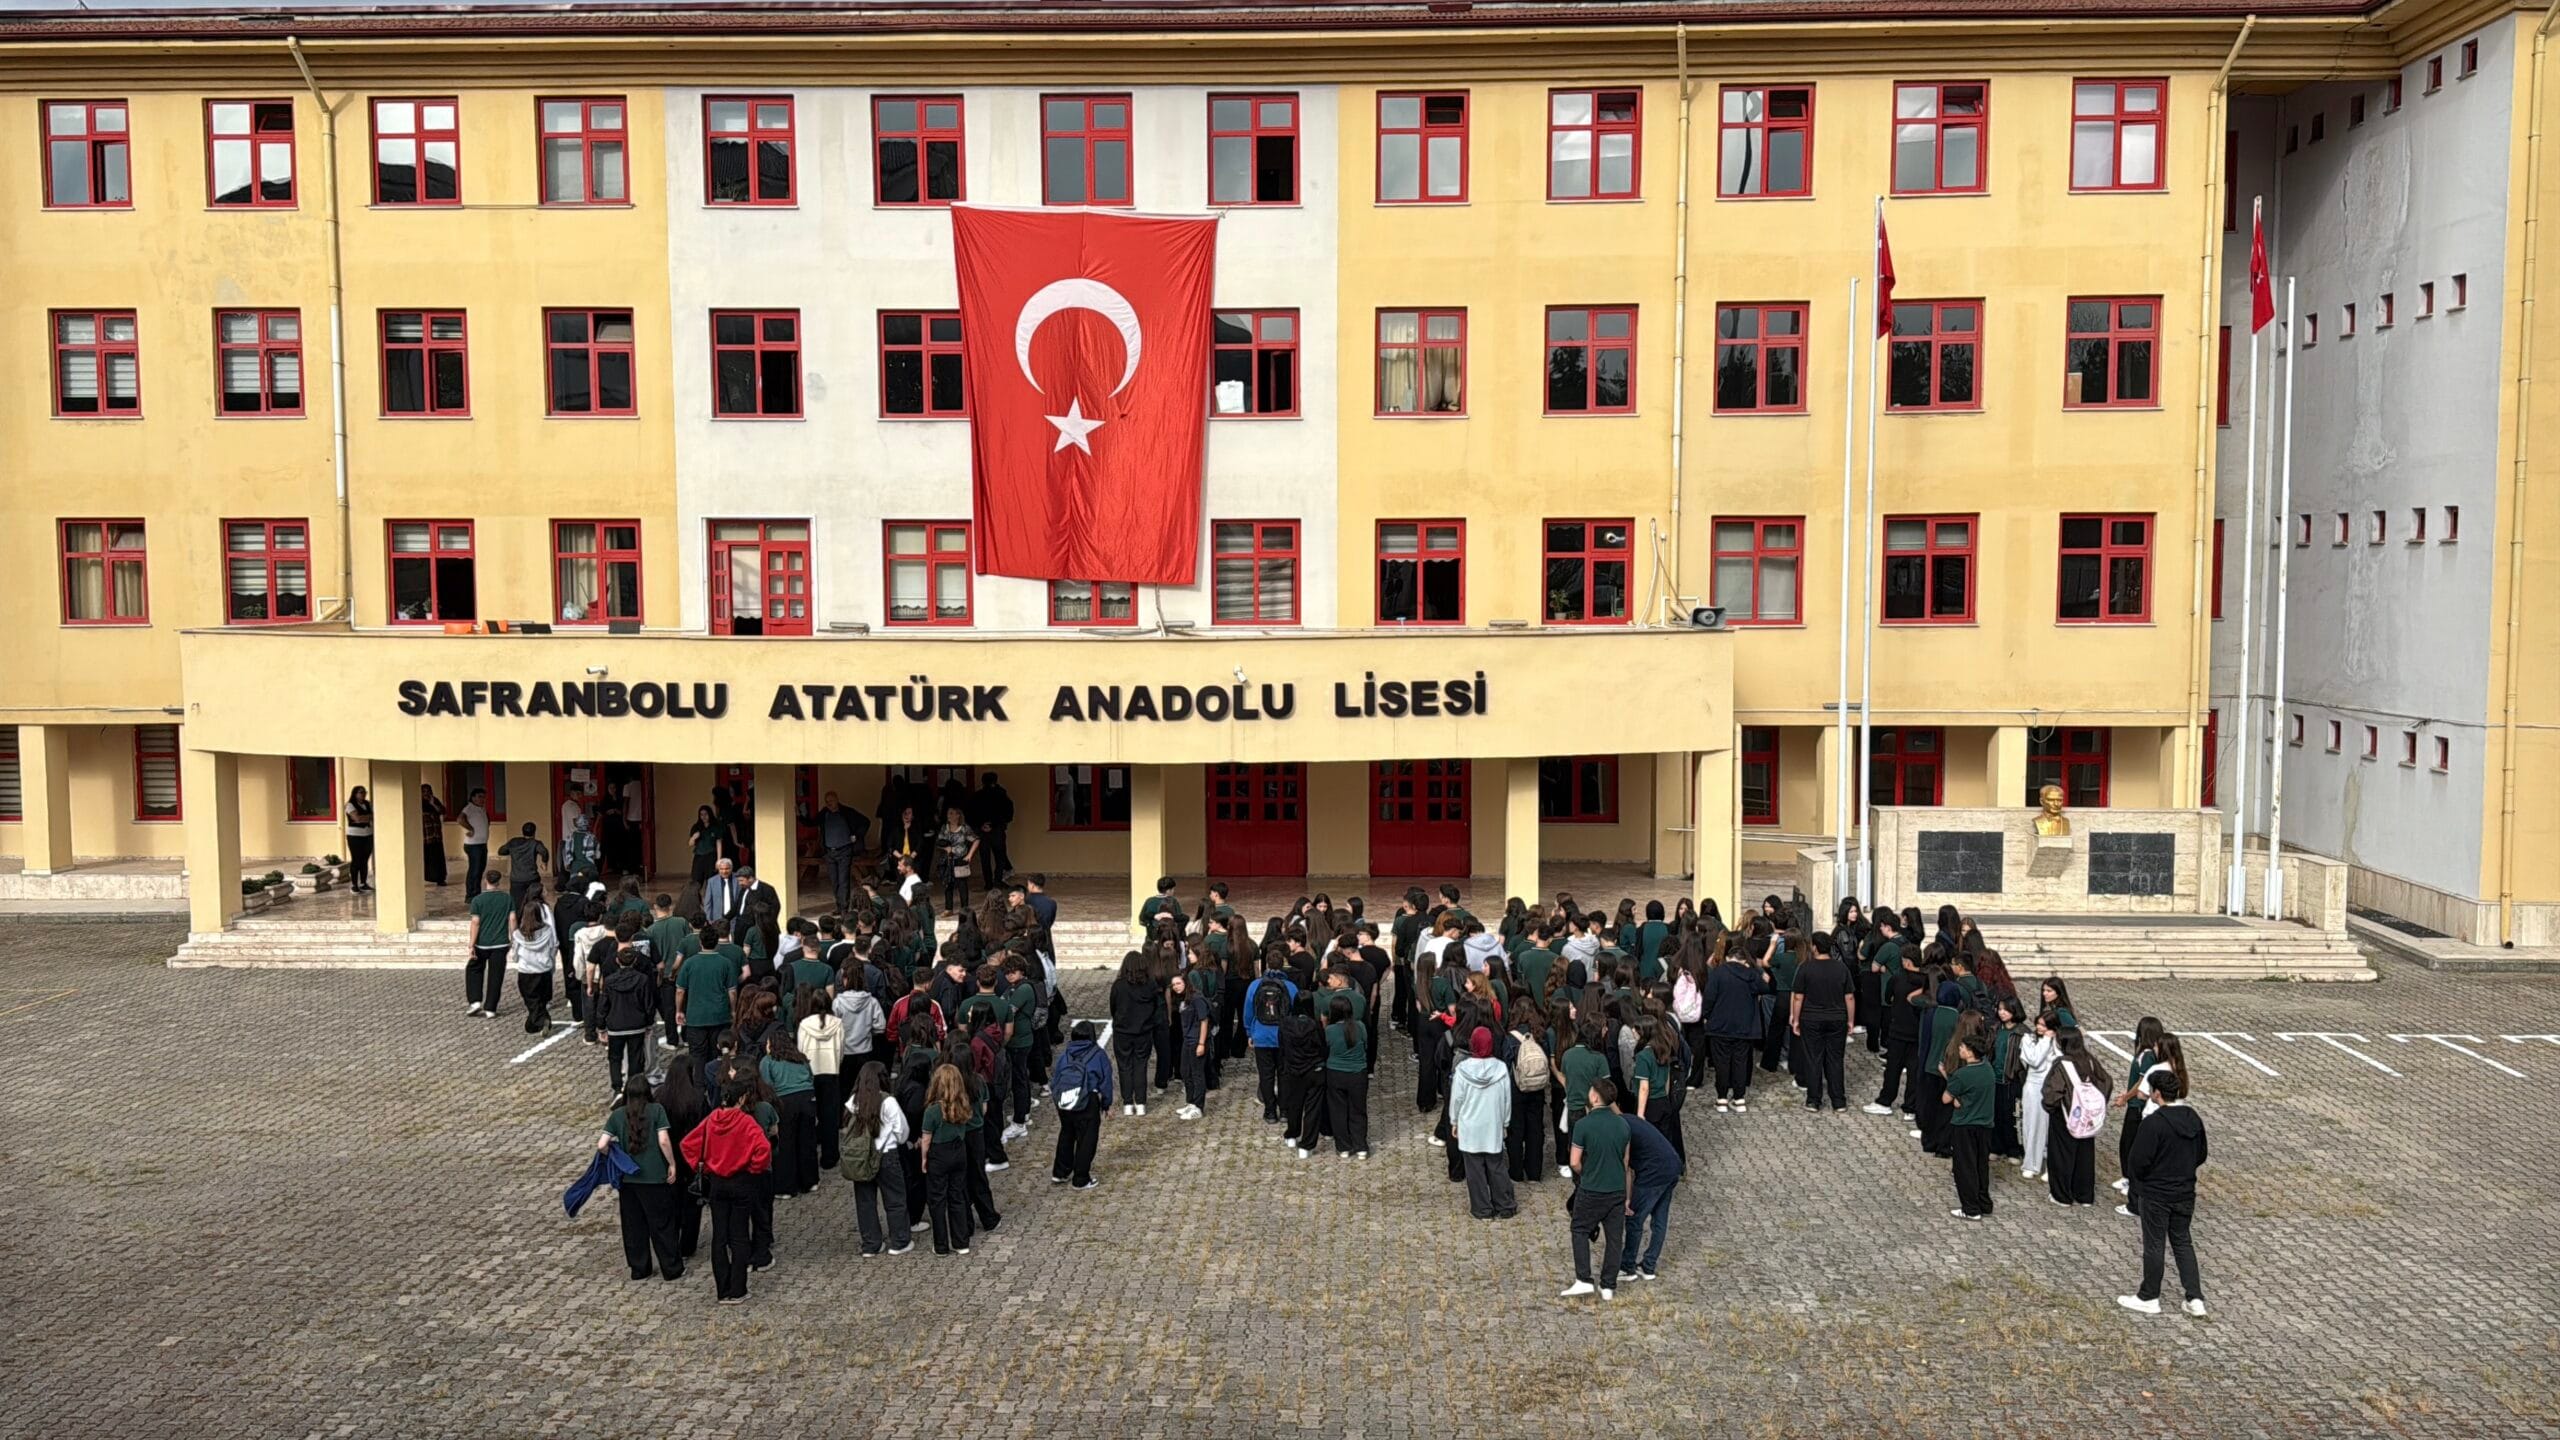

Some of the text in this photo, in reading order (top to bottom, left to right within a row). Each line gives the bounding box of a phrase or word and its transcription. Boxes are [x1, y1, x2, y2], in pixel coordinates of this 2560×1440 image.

[398, 671, 1487, 722] SAFRANBOLU ATATÜRK ANADOLU LİSESİ
